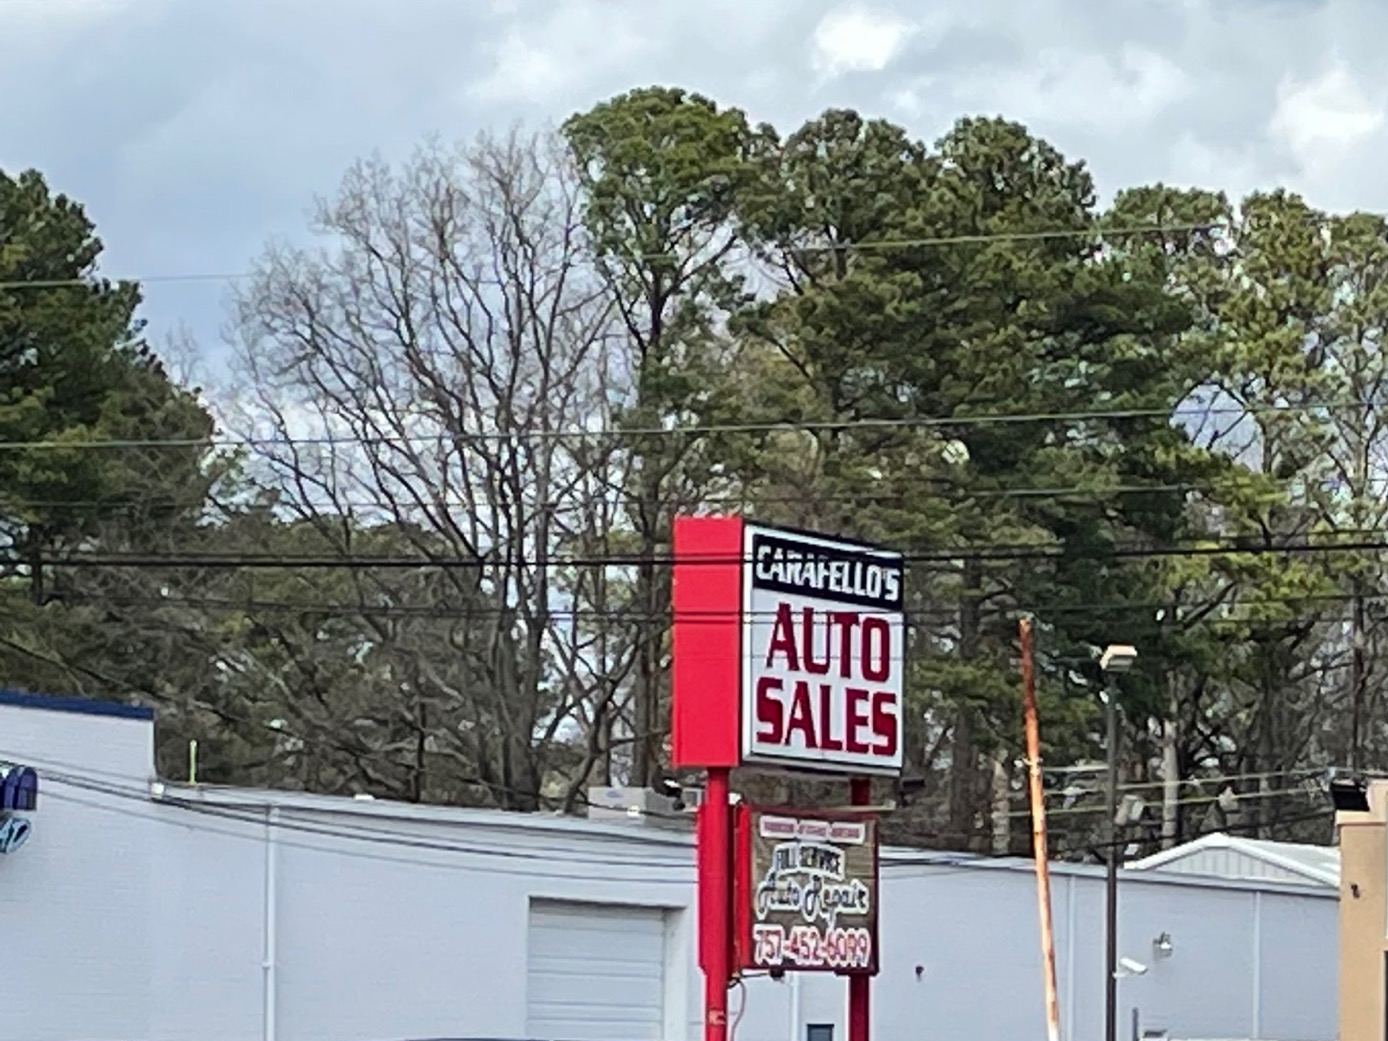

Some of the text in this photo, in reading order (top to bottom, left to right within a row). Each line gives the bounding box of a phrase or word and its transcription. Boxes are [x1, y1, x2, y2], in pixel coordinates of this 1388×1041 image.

[756, 545, 900, 602] CARAFELLO'S
[766, 602, 890, 682] AUTO
[756, 677, 897, 757] SALES
